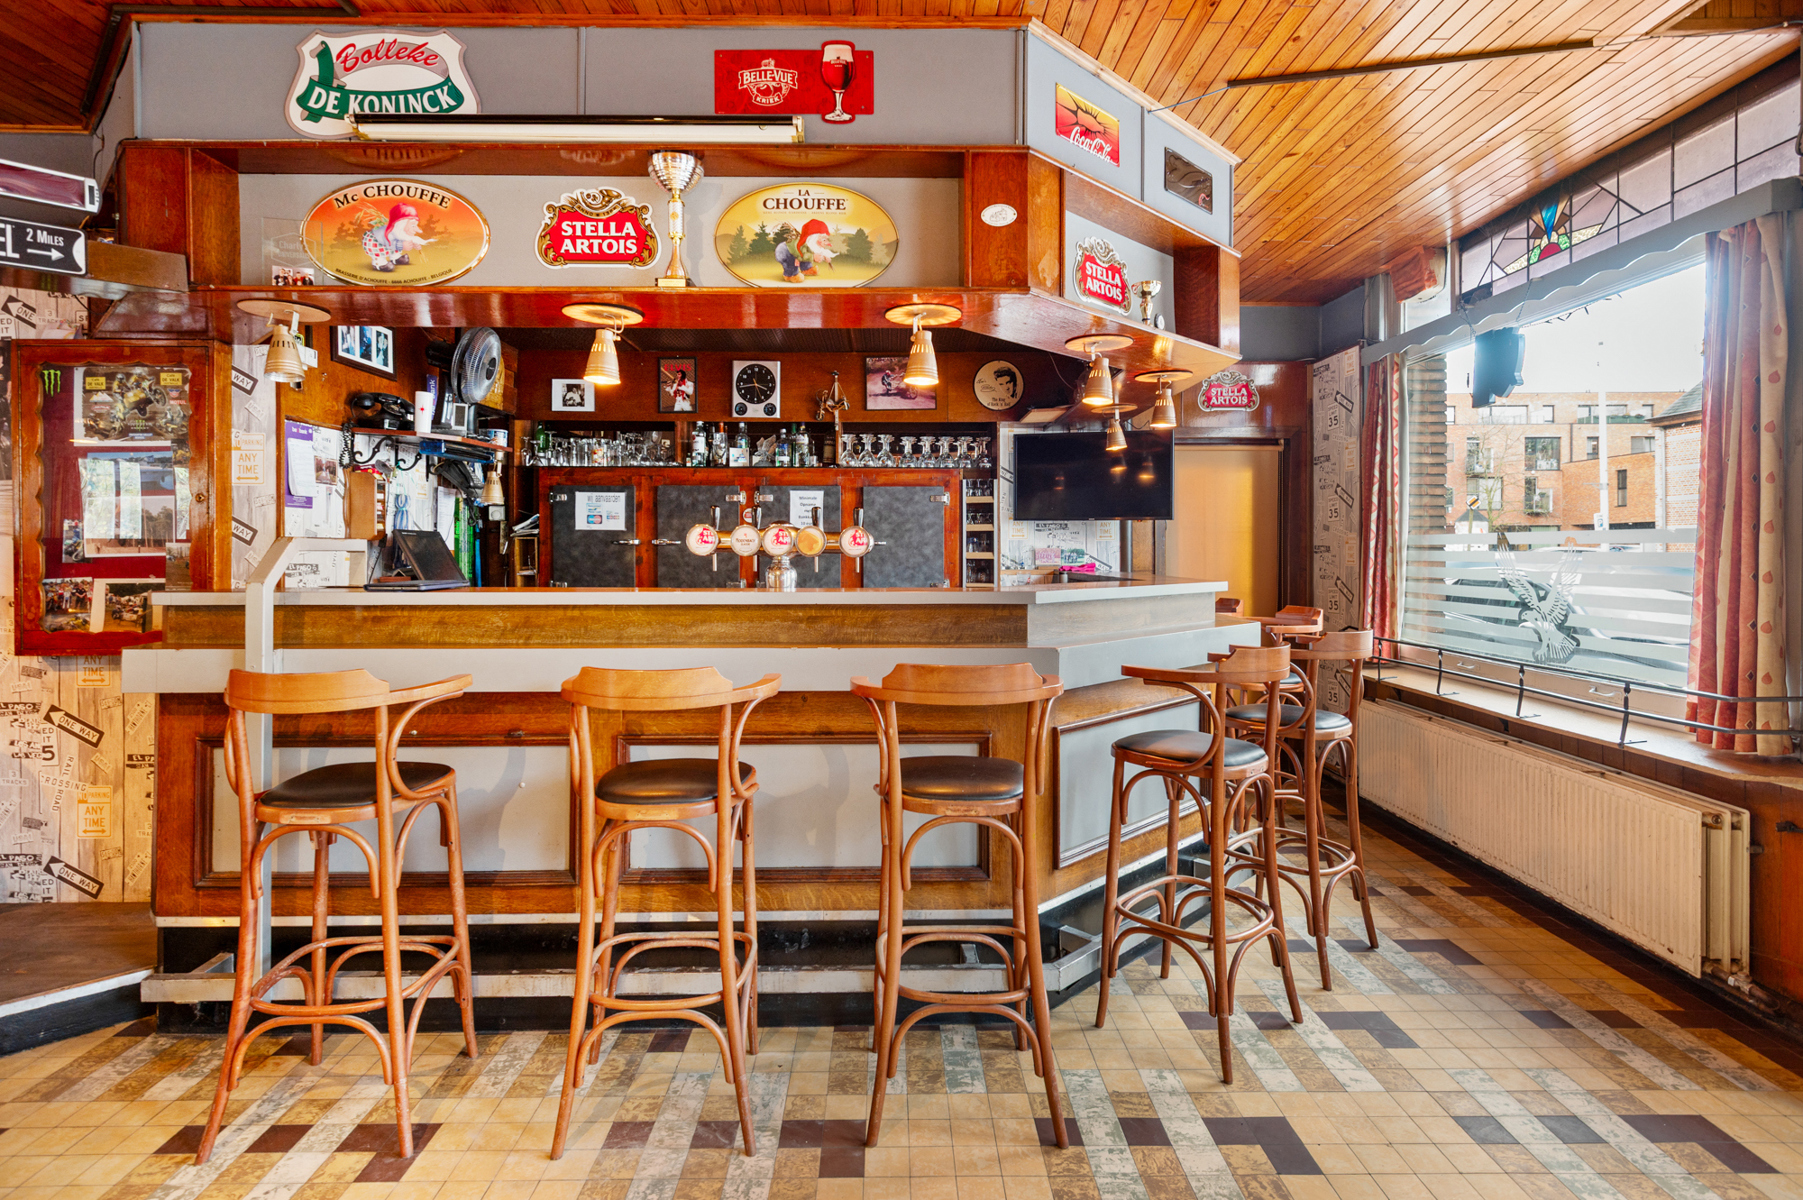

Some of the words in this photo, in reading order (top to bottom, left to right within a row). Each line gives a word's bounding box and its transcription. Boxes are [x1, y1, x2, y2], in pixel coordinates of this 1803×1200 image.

[336, 38, 439, 72] Bolleke
[743, 70, 793, 84] BELLE-VUE
[307, 86, 341, 114] DE
[348, 85, 457, 113] KONINCK
[363, 184, 451, 209] CHOUFFE
[762, 197, 847, 211] CHOUFFE
[26, 228, 33, 242] 2
[561, 221, 637, 237] STELLA
[560, 238, 638, 254] ARTOIS
[1085, 261, 1121, 286] STELLA
[1085, 277, 1123, 301] ARTOIS
[16, 306, 35, 321] ONE
[664, 363, 692, 372] ELVIS
[233, 373, 251, 387] WAY
[1211, 387, 1248, 397] STELLA
[1210, 396, 1248, 406] ARTOIS
[1328, 415, 1339, 427] 35
[238, 453, 258, 462] ANY
[237, 464, 259, 474] TIME
[1328, 508, 1339, 519] 35
[233, 523, 251, 539] WAY
[1328, 600, 1339, 611] 35
[83, 667, 105, 676] TIME
[1328, 691, 1338, 703] 35
[58, 715, 76, 730] ONE
[79, 727, 98, 741] WAY
[84, 805, 105, 815] ANY
[83, 817, 106, 828] TIME
[58, 867, 77, 881] ONE
[78, 877, 98, 892] WAY
